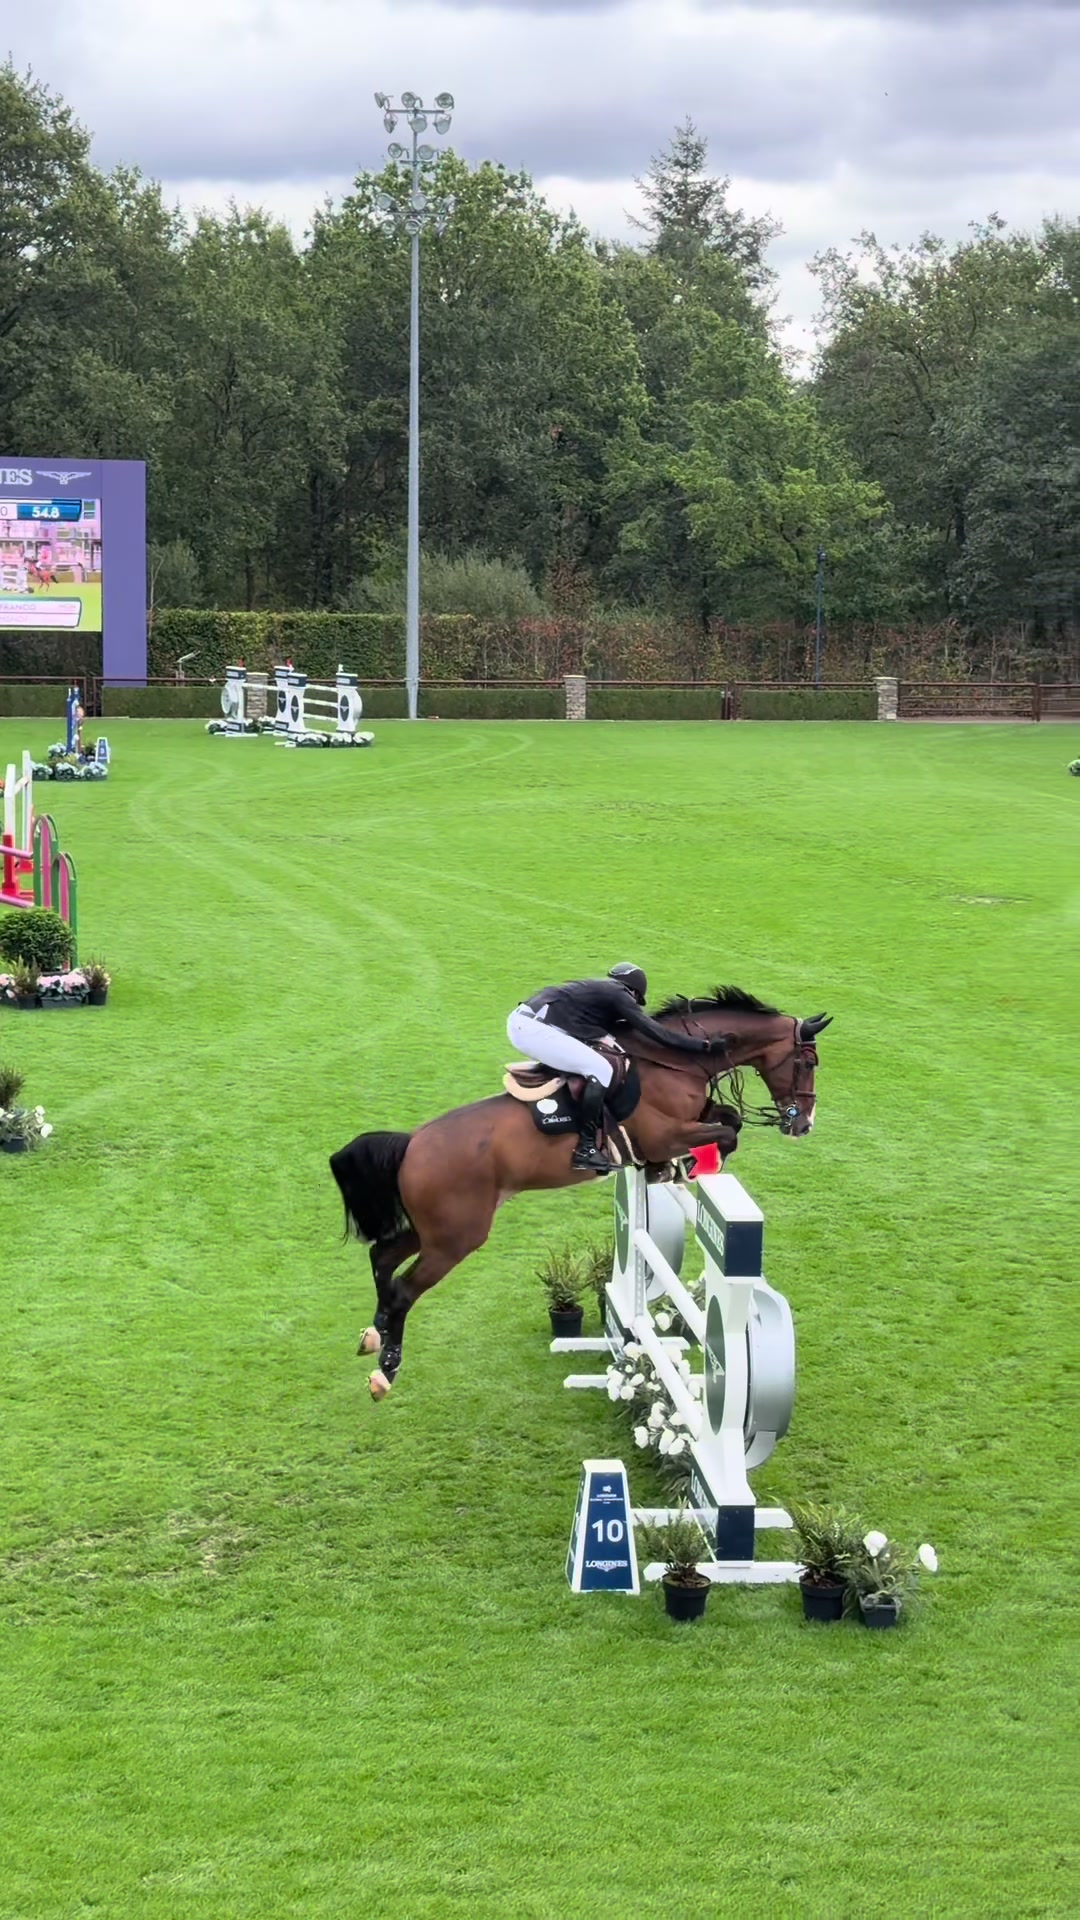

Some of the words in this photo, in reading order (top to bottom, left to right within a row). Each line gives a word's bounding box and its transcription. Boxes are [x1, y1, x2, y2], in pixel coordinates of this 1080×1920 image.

[31, 506, 60, 518] 54.8
[591, 1519, 624, 1542] 10
[585, 1560, 628, 1568] LONGINES
